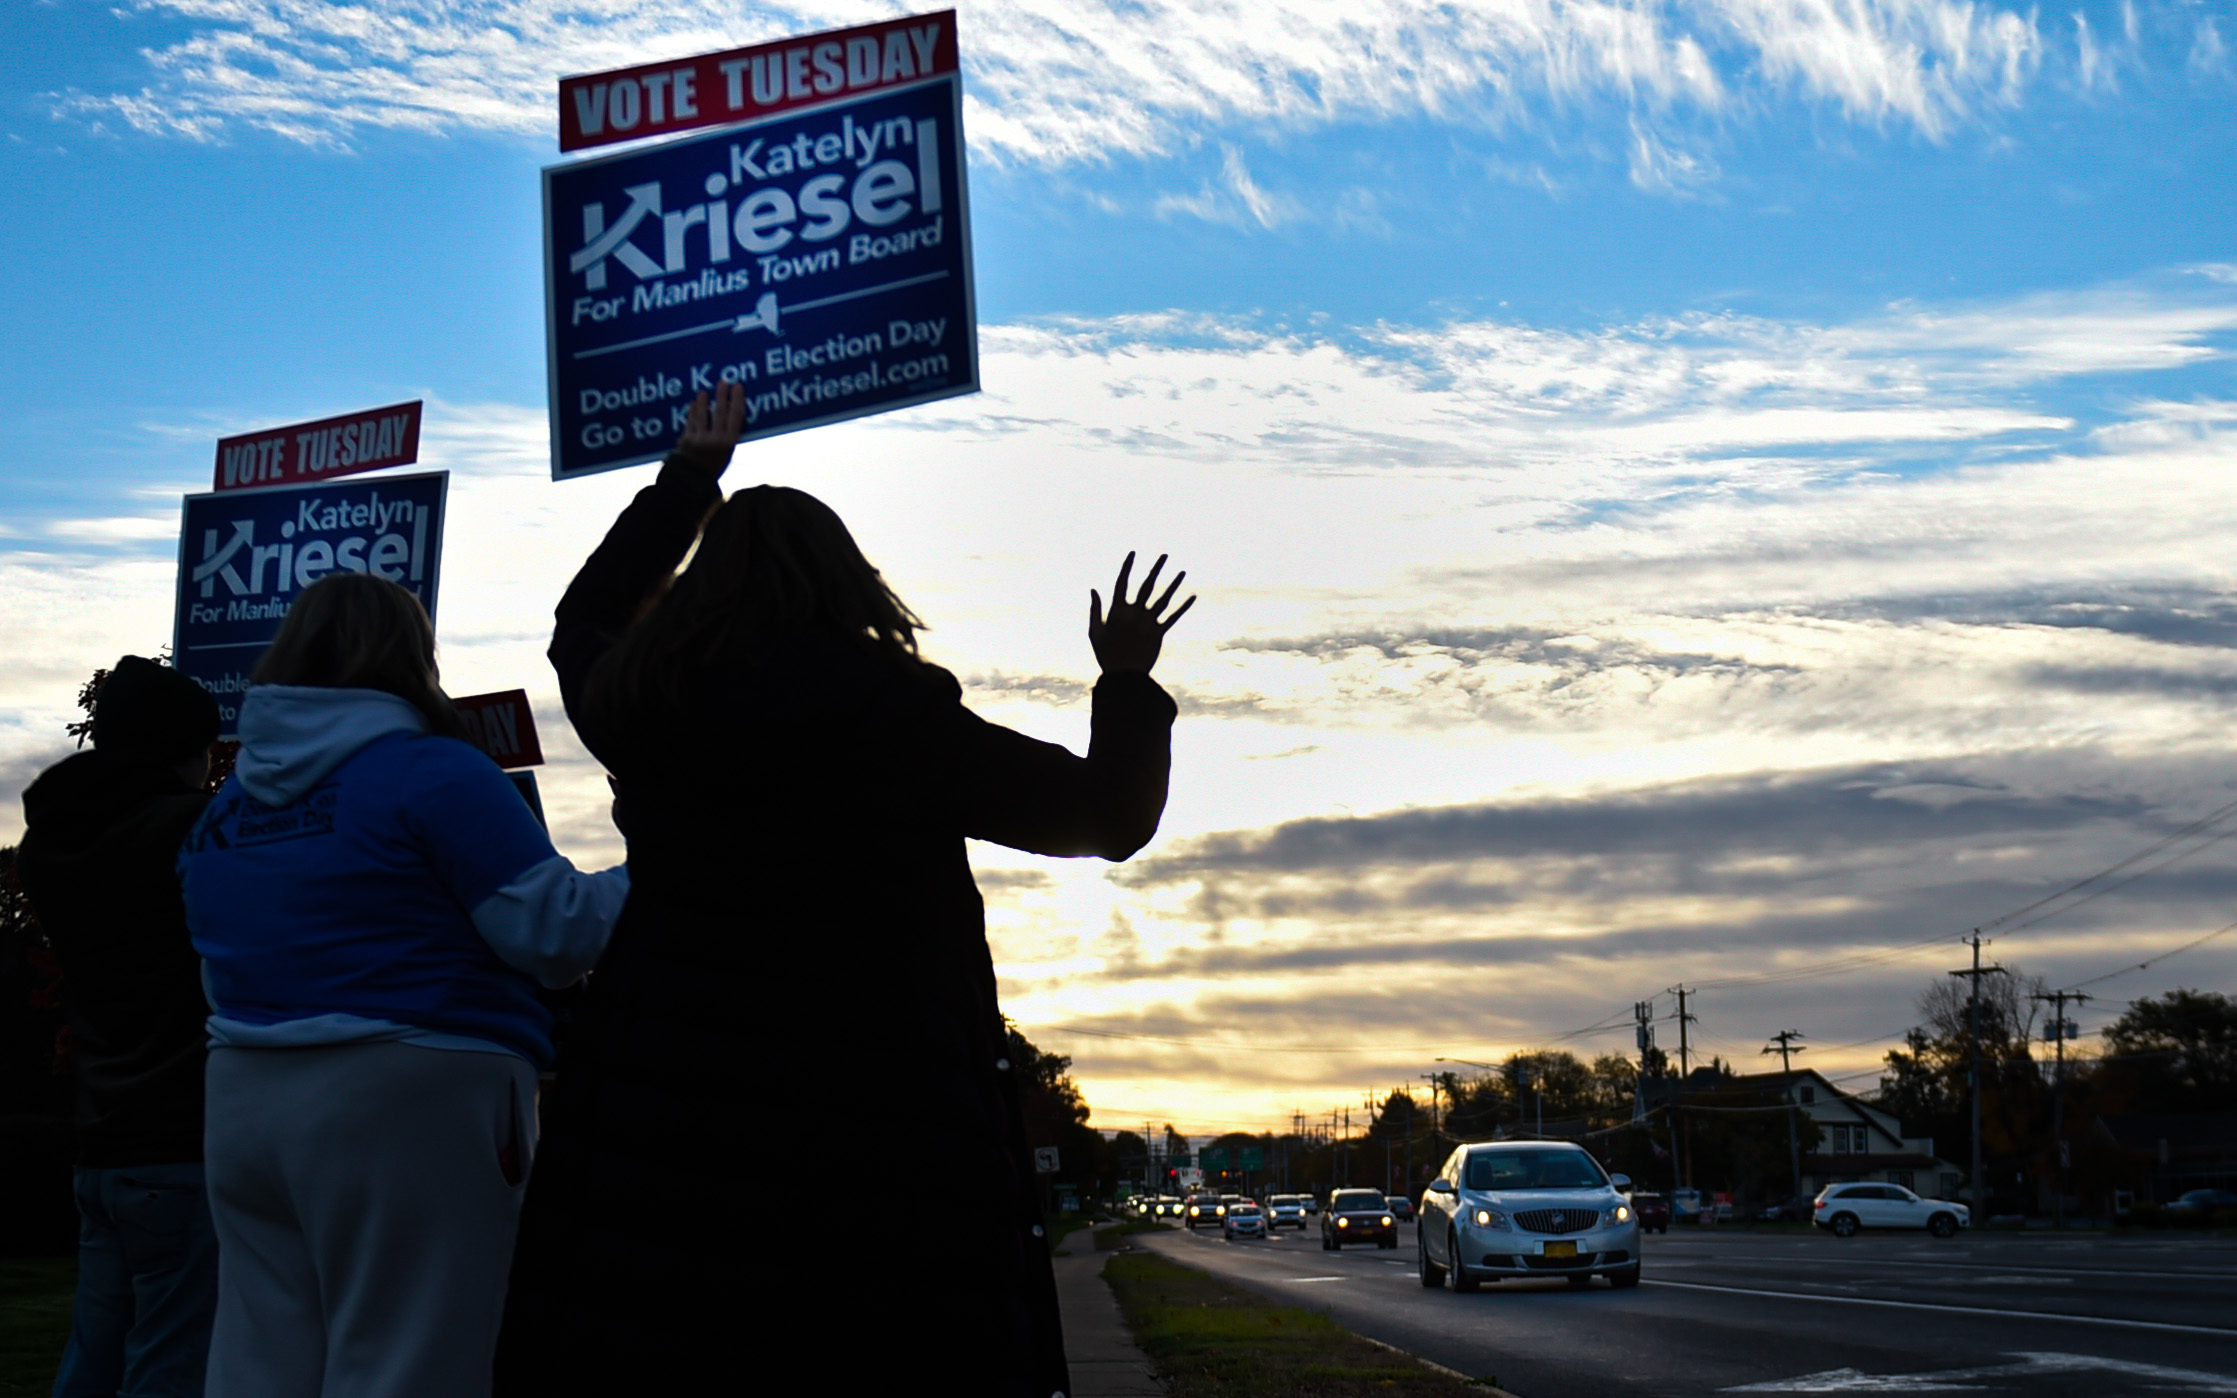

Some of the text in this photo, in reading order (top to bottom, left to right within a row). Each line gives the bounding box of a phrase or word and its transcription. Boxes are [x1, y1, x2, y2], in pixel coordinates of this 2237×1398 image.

[573, 24, 940, 137] VOTE TUESDAY
[730, 115, 914, 185] Katelyn
[570, 118, 942, 291] Kriesel
[572, 215, 943, 326] For Manlius Town Board
[580, 317, 947, 415] Double K on Election Day
[581, 423, 624, 449] Go
[631, 418, 663, 440] to
[670, 353, 949, 433] KynKriesel.com
[223, 413, 409, 487] VOTE TUESDAY
[192, 505, 429, 598] Kriesel
[298, 491, 413, 535] Katelyn
[190, 596, 293, 624] For Manliu
